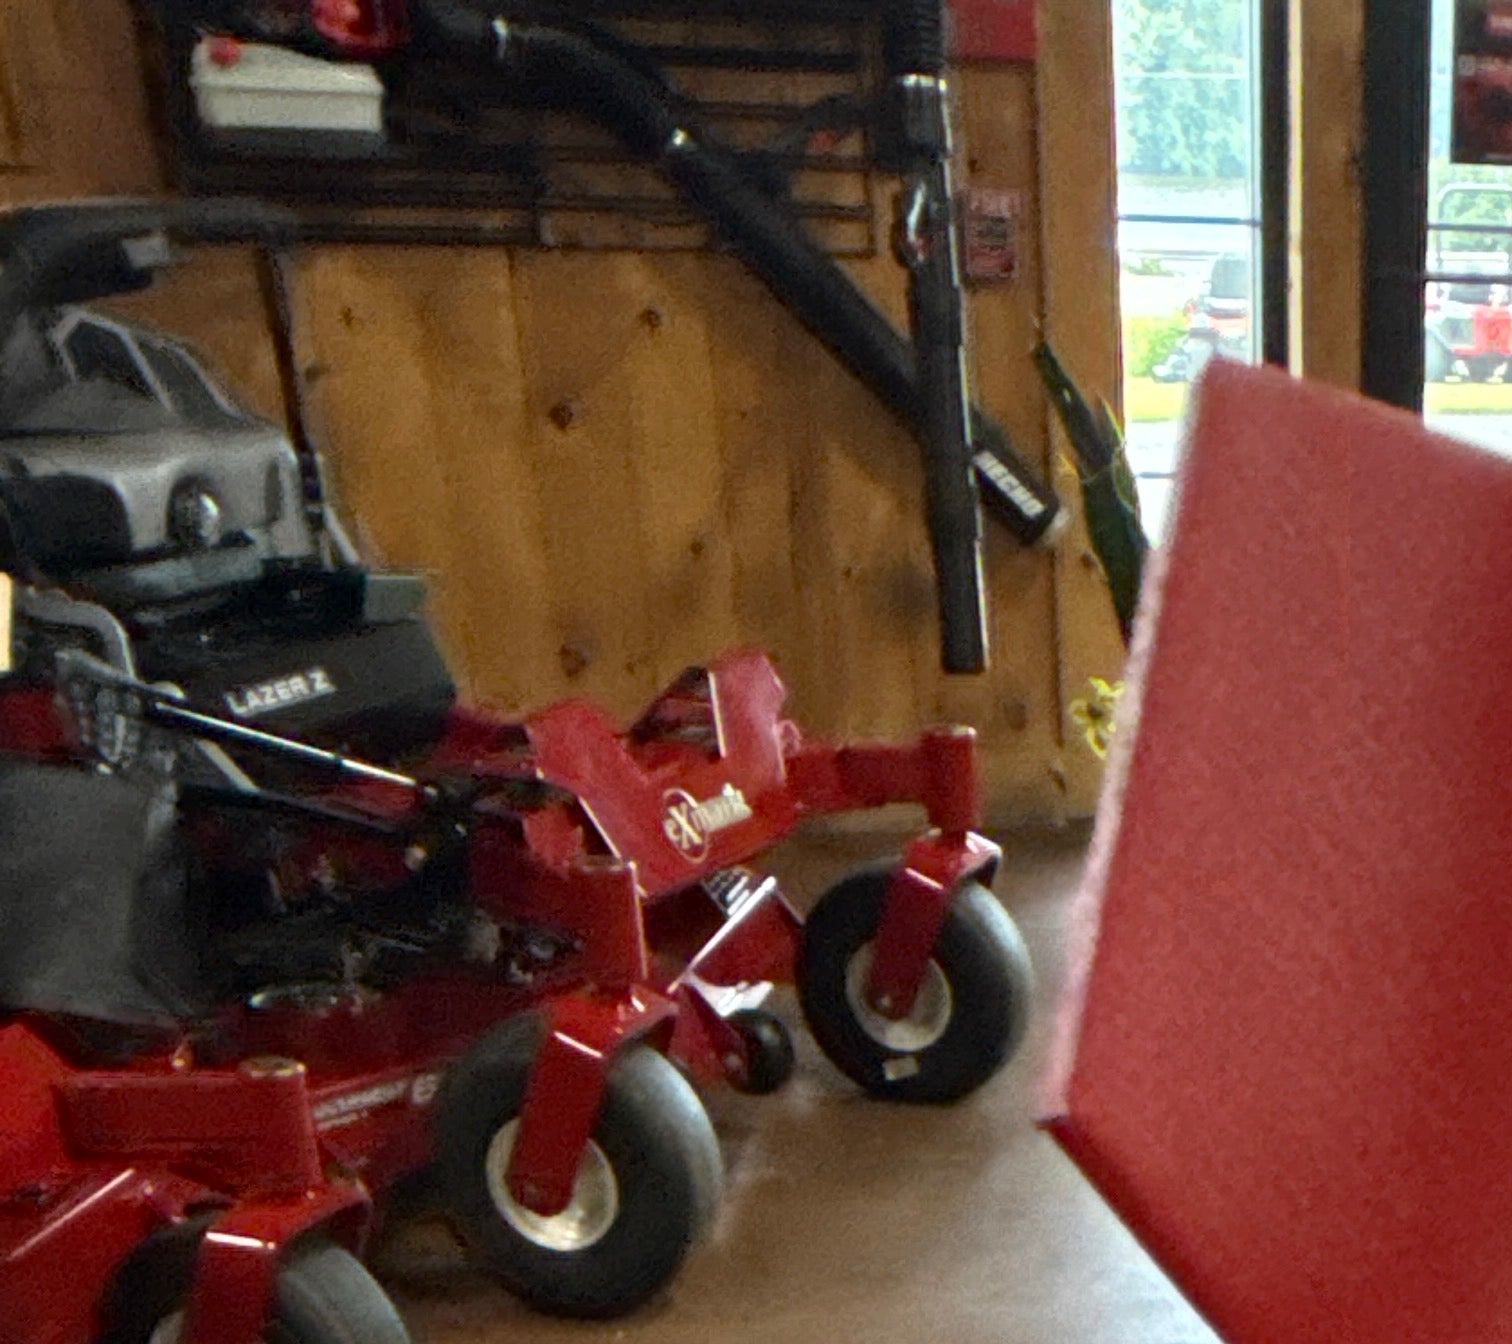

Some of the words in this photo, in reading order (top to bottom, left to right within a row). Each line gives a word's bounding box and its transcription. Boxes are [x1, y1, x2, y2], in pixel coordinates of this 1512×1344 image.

[985, 461, 1045, 518] ECHO
[224, 674, 311, 716] LAZER
[308, 667, 337, 695] Z
